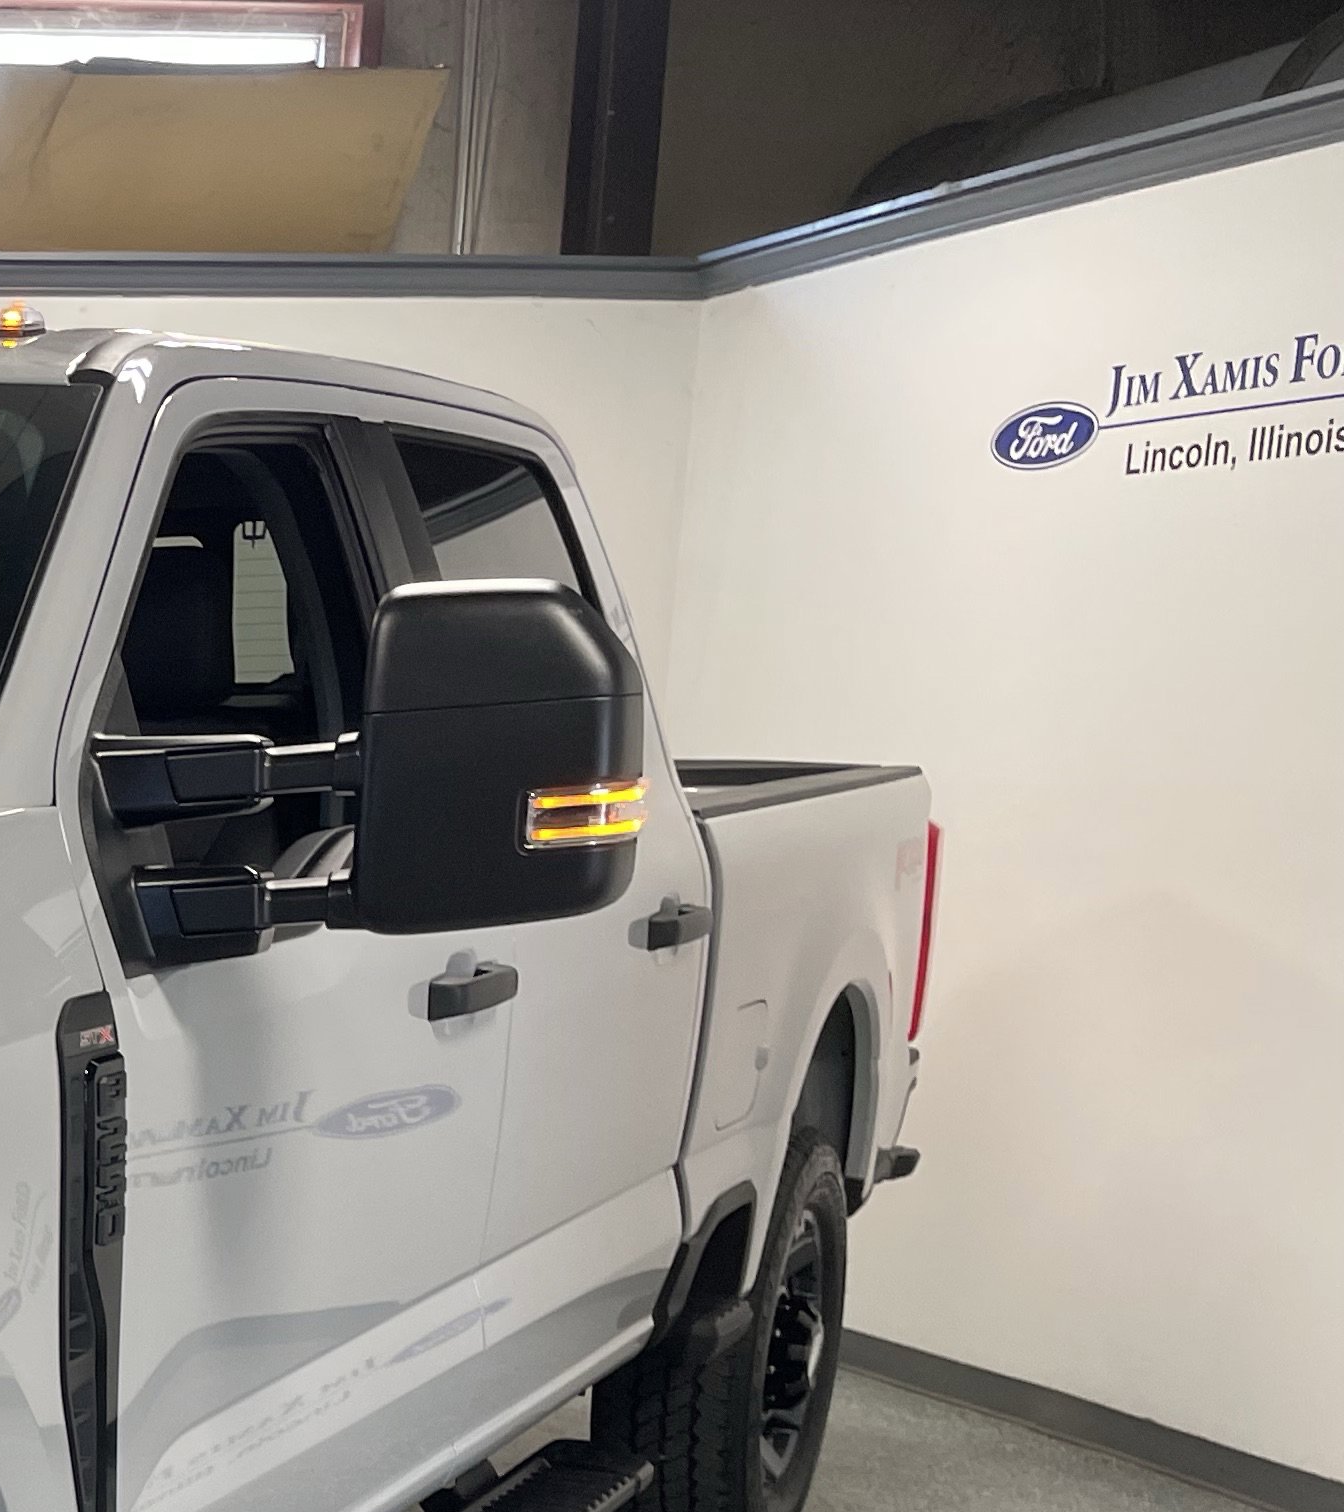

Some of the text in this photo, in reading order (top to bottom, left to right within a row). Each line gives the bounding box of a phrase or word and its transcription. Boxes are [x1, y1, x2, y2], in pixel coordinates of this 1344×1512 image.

[1289, 333, 1344, 384] FO
[1010, 415, 1078, 461] Ford
[1125, 431, 1237, 476] Lincoln,
